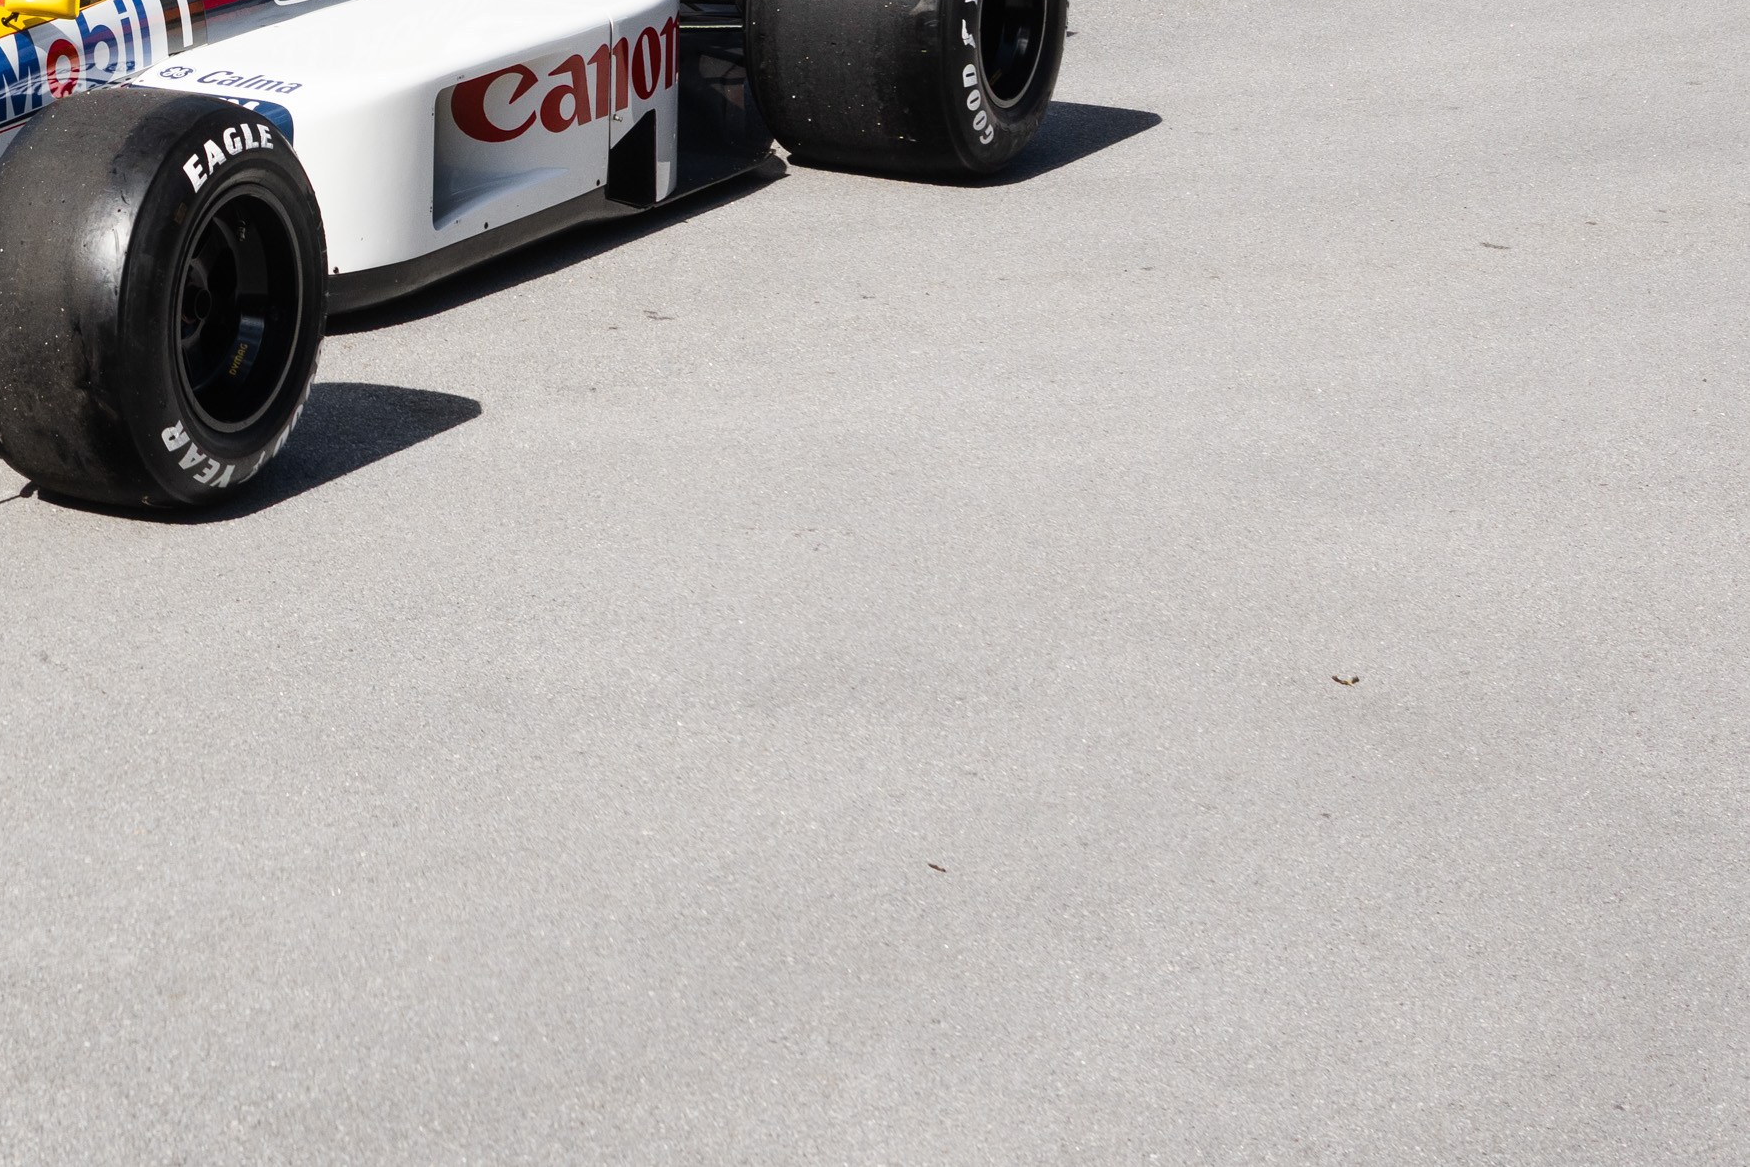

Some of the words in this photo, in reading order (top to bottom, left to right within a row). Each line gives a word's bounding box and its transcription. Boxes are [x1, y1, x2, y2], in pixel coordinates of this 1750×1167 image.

[196, 70, 303, 95] Calma
[451, 11, 680, 143] Canon
[182, 122, 275, 194] EAGLE
